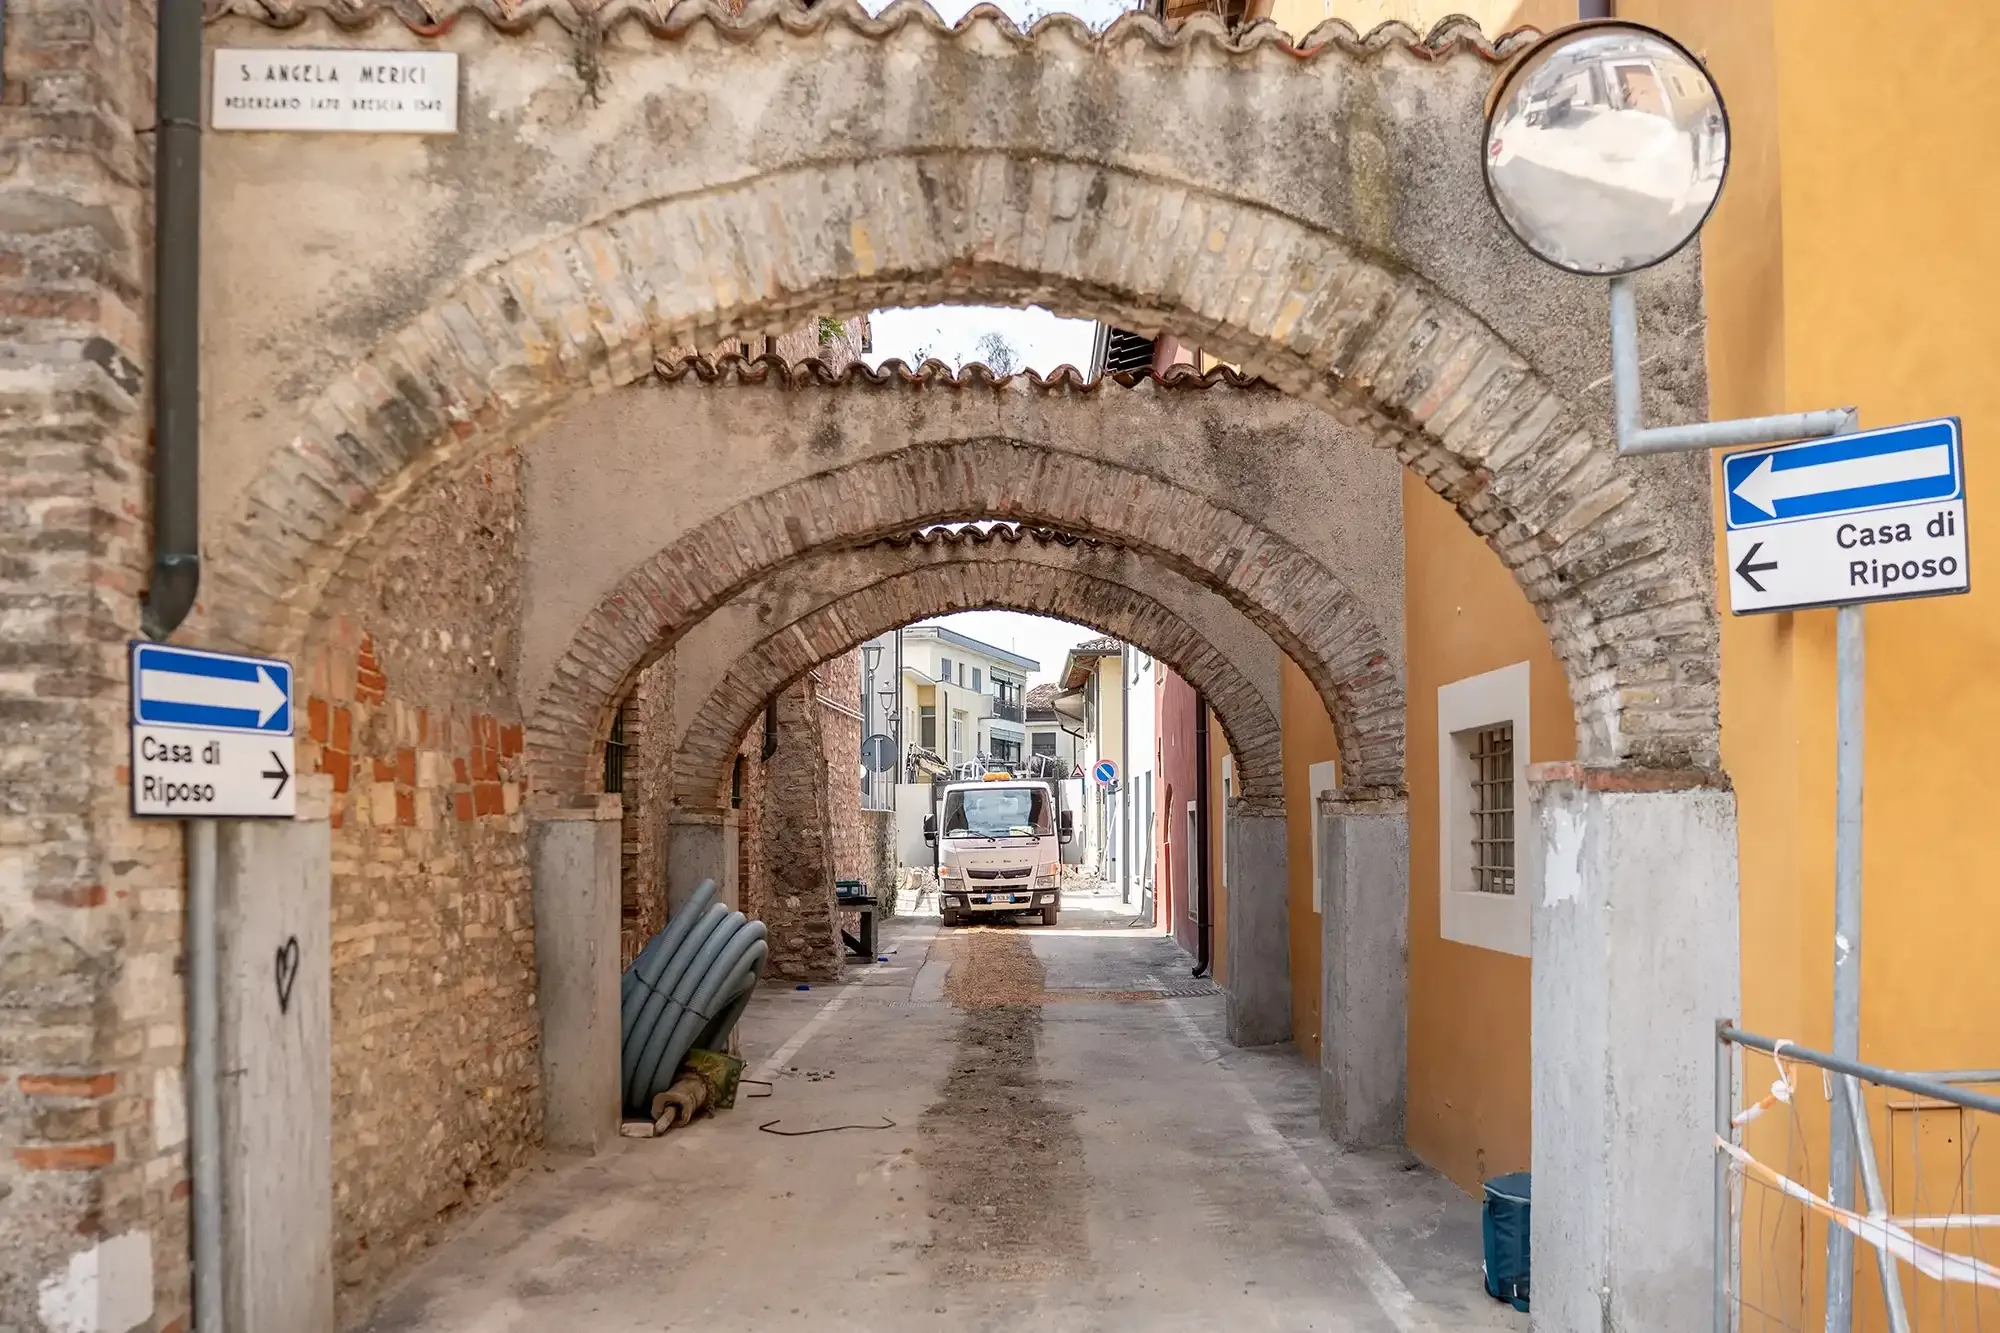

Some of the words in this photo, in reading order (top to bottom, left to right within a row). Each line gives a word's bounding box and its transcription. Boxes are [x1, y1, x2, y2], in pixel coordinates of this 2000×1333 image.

[264, 65, 340, 82] ANGELA
[360, 66, 428, 84] MERICI
[352, 98, 405, 112] BRESCIA
[1837, 523, 1912, 549] Casa
[1926, 511, 1956, 538] di
[1850, 556, 1958, 588] Riposo
[142, 735, 192, 764] Casa
[202, 741, 220, 765] di
[142, 775, 215, 806] Riposo
